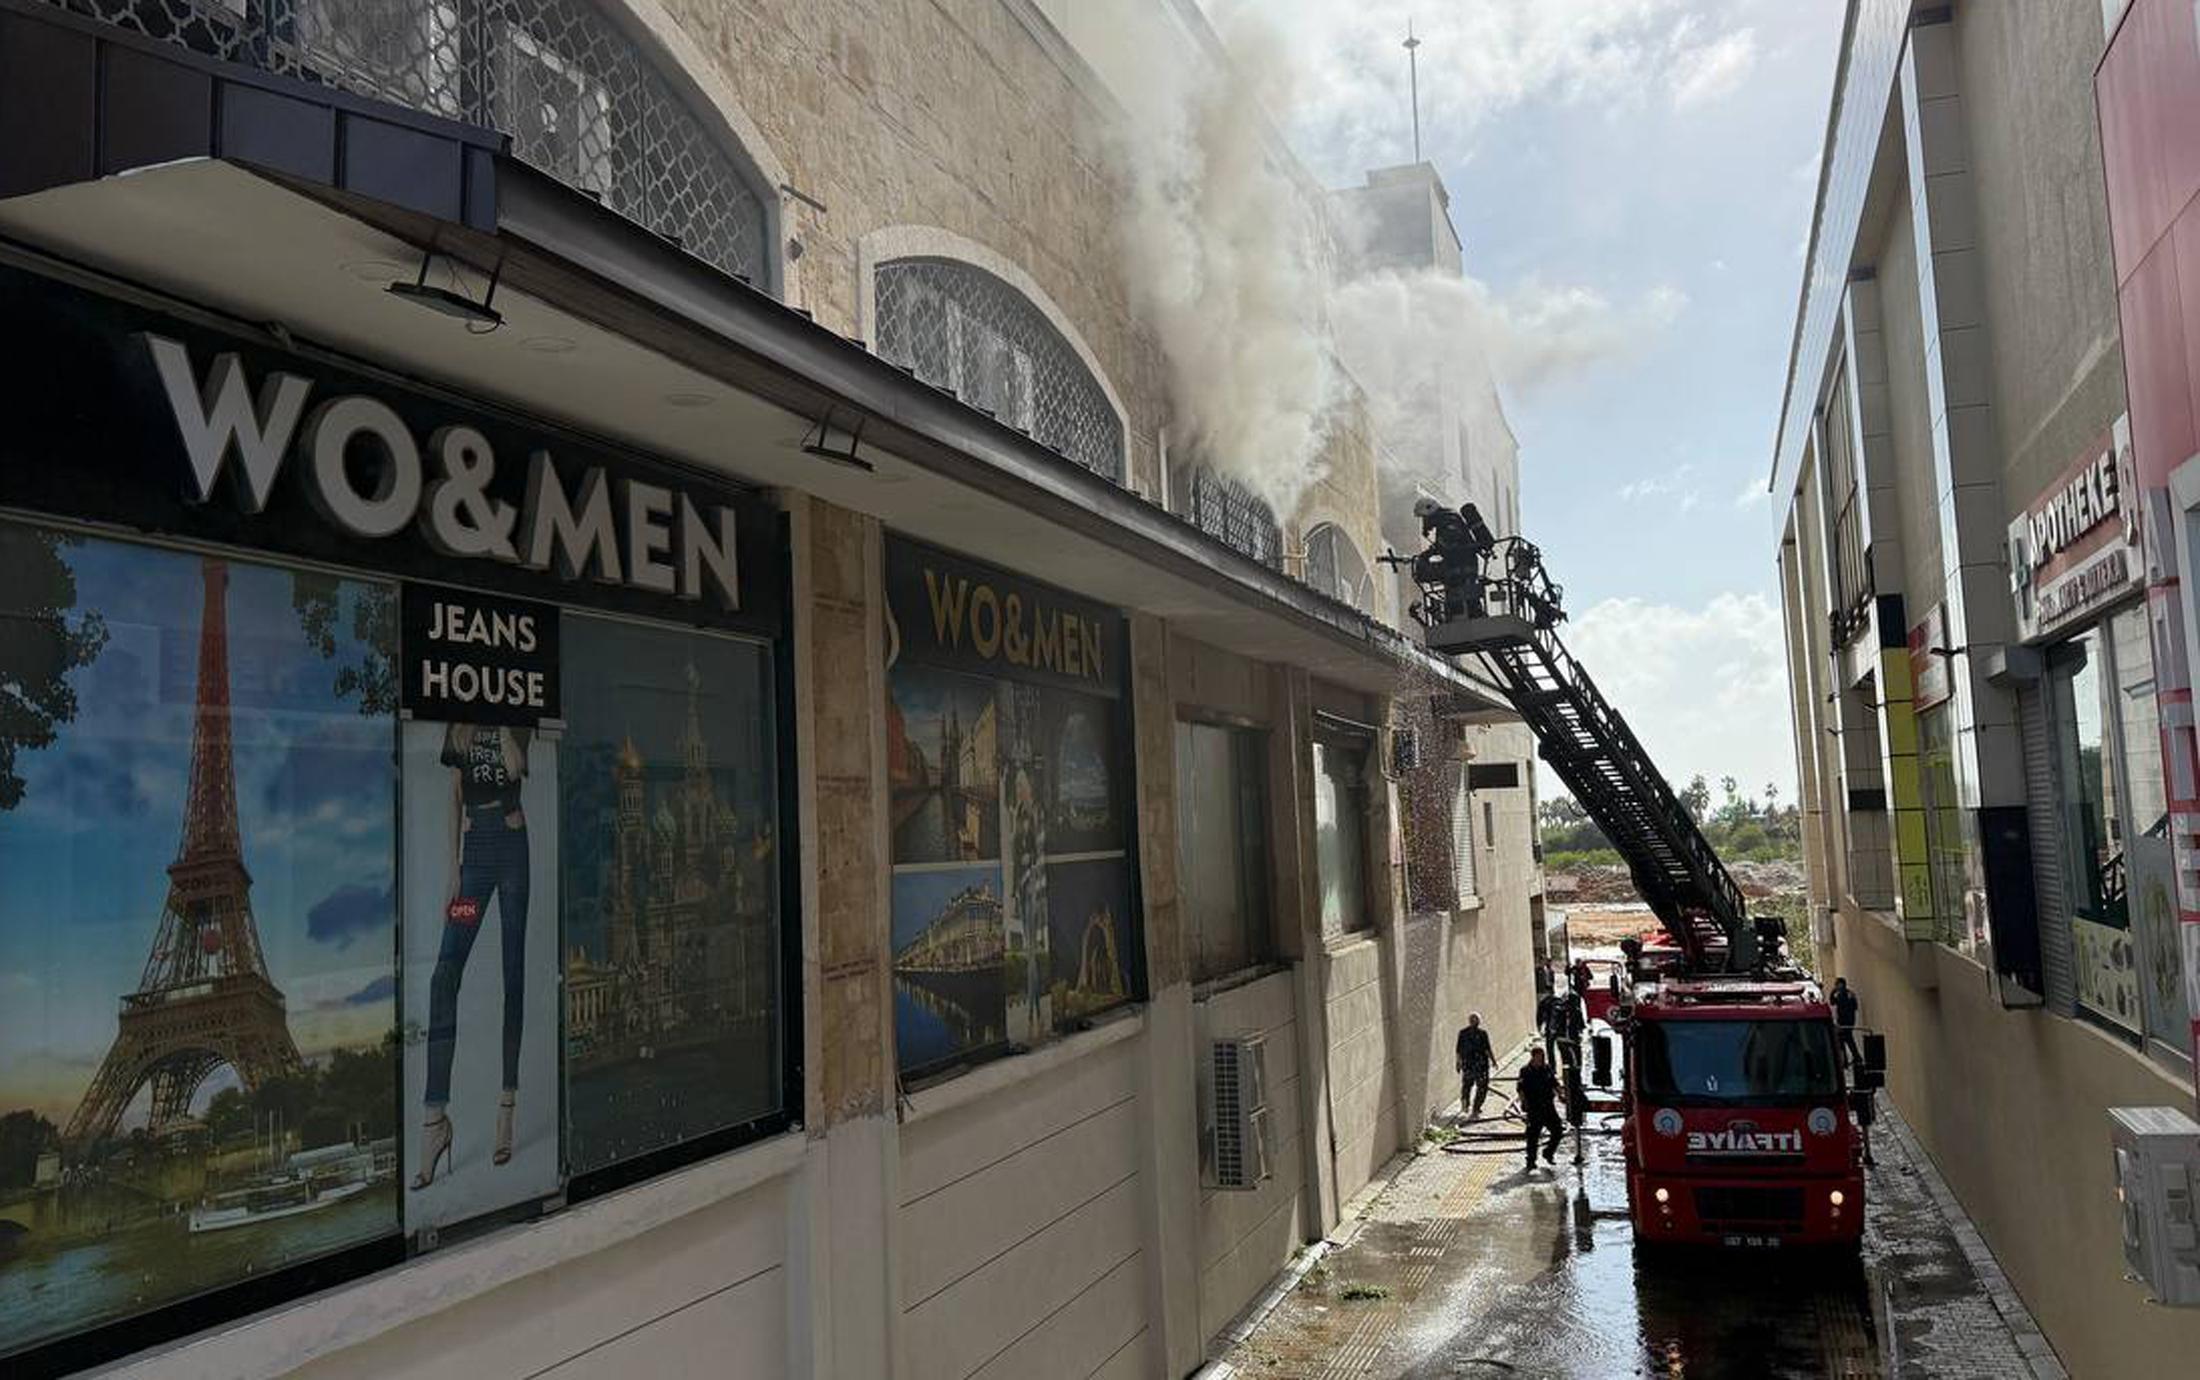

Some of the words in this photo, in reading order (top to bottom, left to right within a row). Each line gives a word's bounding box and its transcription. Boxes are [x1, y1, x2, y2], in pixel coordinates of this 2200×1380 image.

[139, 333, 739, 610] WO&MEN
[2028, 450, 2116, 567] APOTHEKE
[423, 659, 544, 707] HOUSE
[428, 602, 537, 652] JEANS
[924, 568, 1104, 683] WO&MEN
